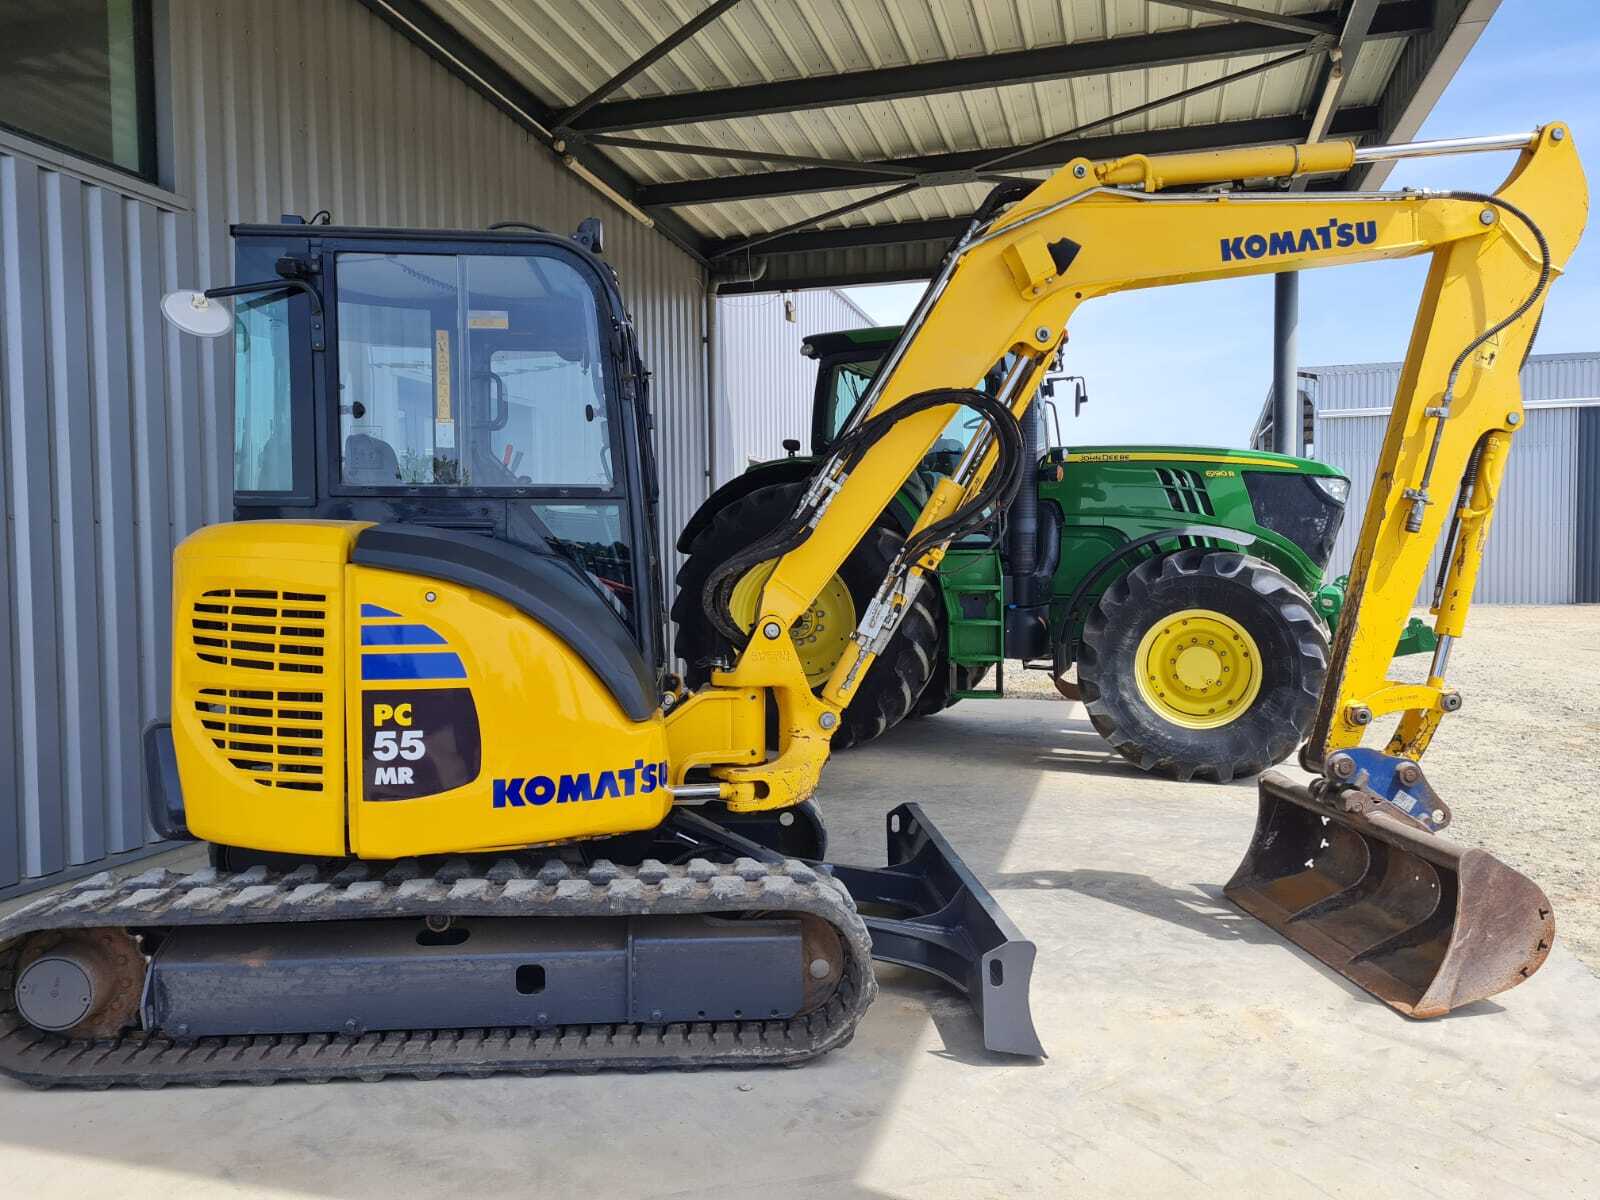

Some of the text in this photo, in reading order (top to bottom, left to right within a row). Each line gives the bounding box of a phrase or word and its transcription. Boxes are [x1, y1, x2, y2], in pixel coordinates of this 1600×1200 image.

[1220, 218, 1377, 261] KOMATSU
[1080, 453, 1130, 463] JOHN DEERE
[373, 703, 412, 727] PC
[372, 730, 426, 761] 55
[374, 767, 414, 785] MR
